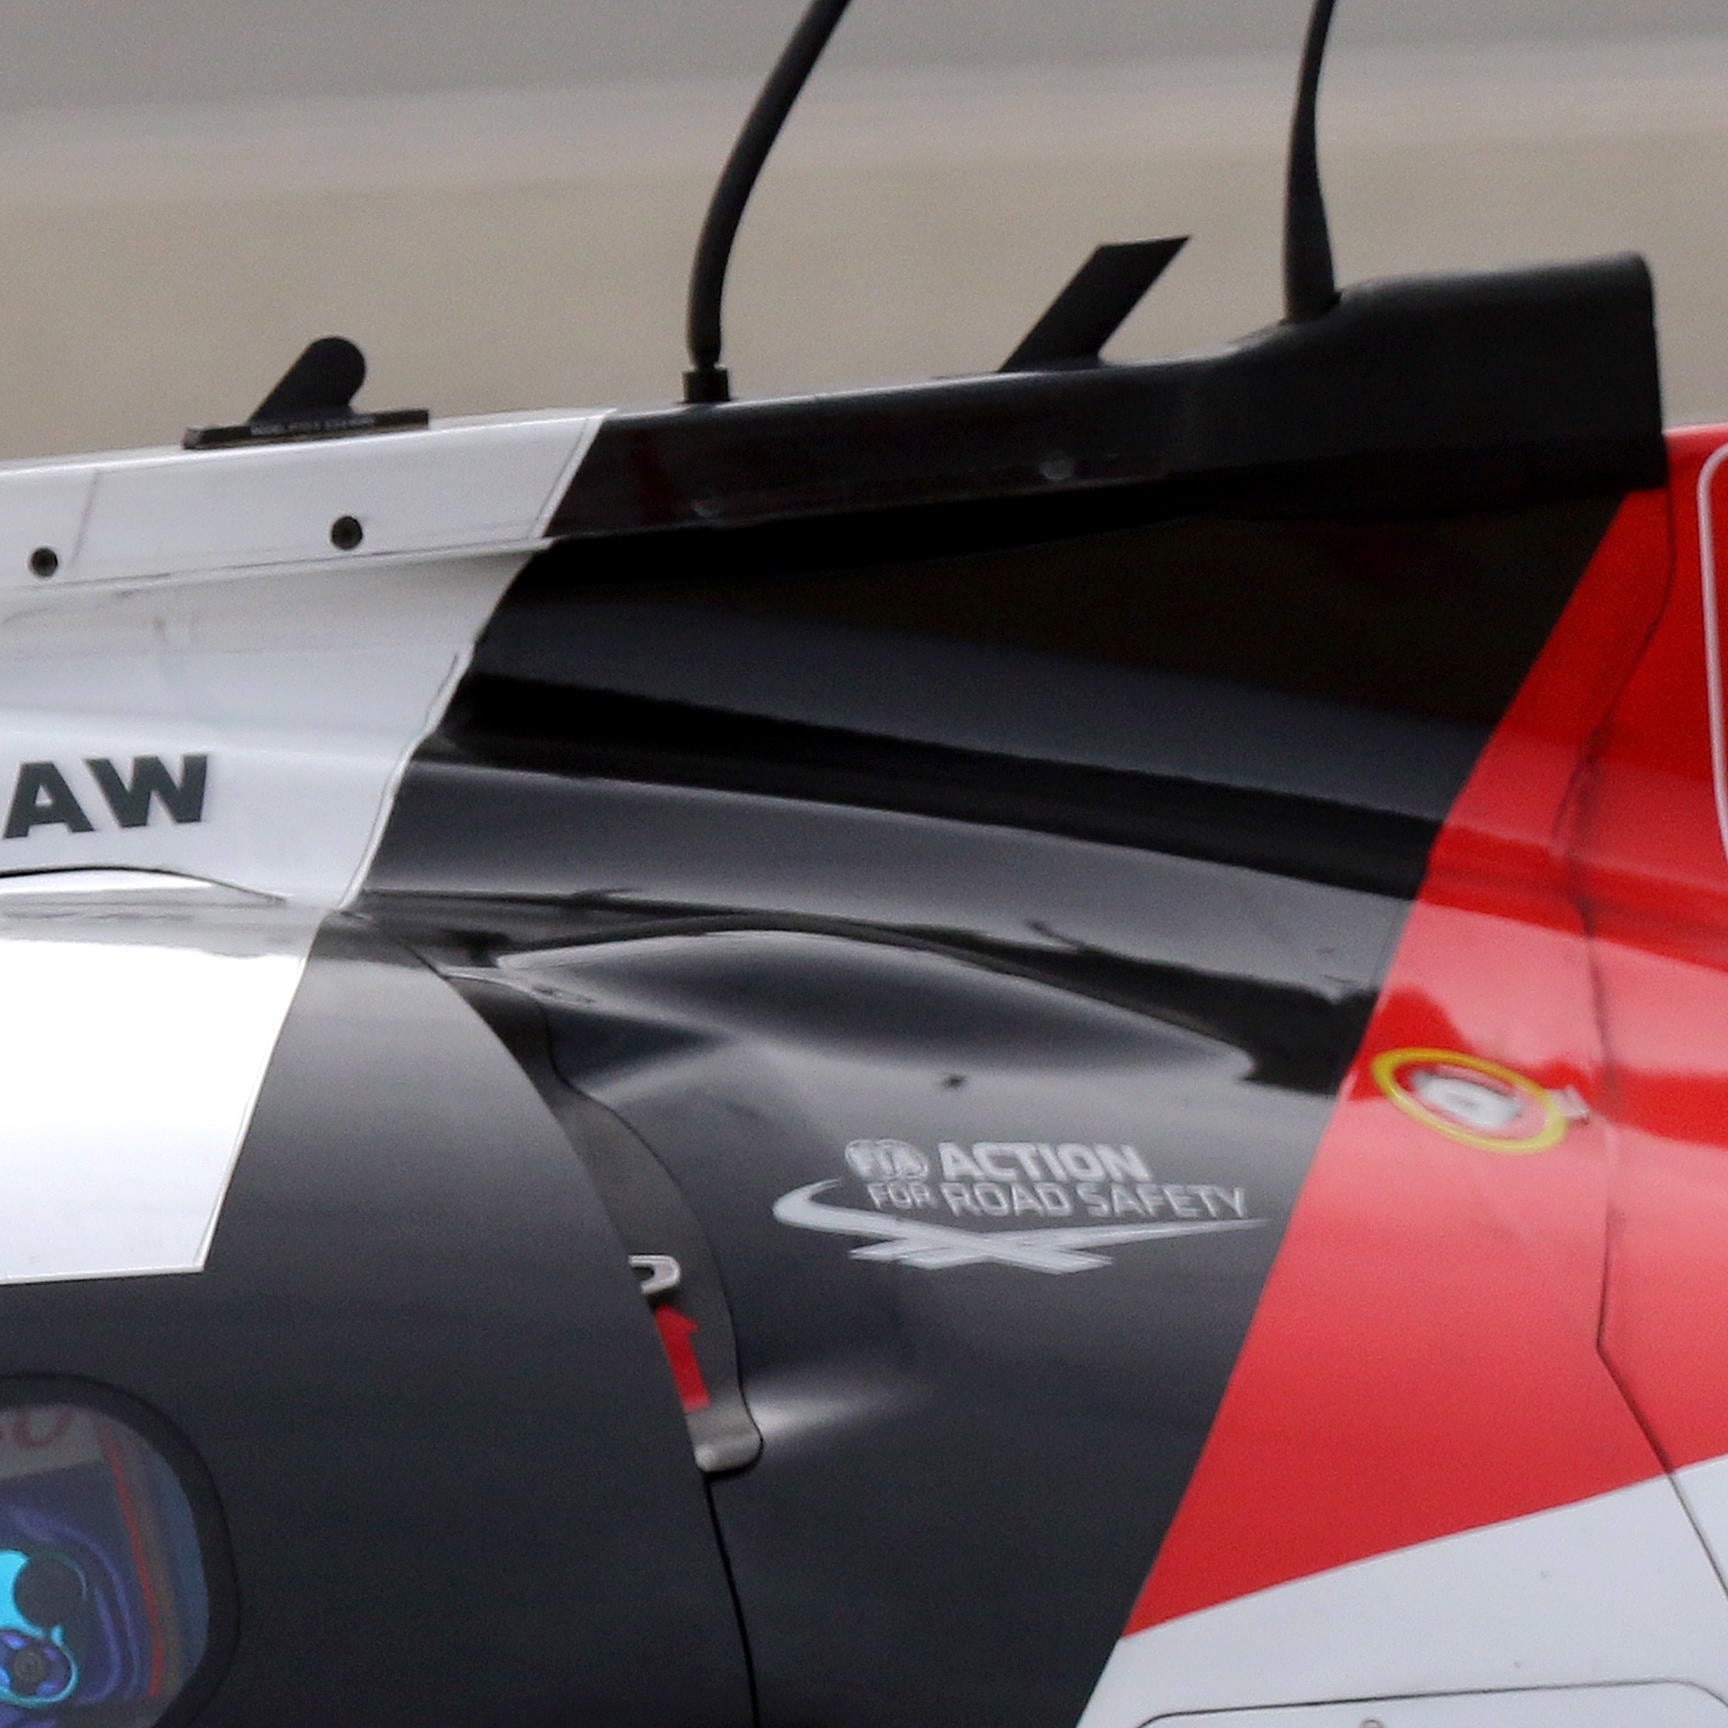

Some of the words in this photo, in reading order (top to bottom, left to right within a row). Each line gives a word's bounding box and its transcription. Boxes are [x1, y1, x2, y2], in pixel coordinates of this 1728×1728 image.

[1, 754, 211, 840] AW
[938, 1142, 1153, 1182] ACTION
[868, 1183, 938, 1210] FOR
[942, 1182, 1072, 1218] ROAD
[1076, 1184, 1246, 1219] SAFETY
